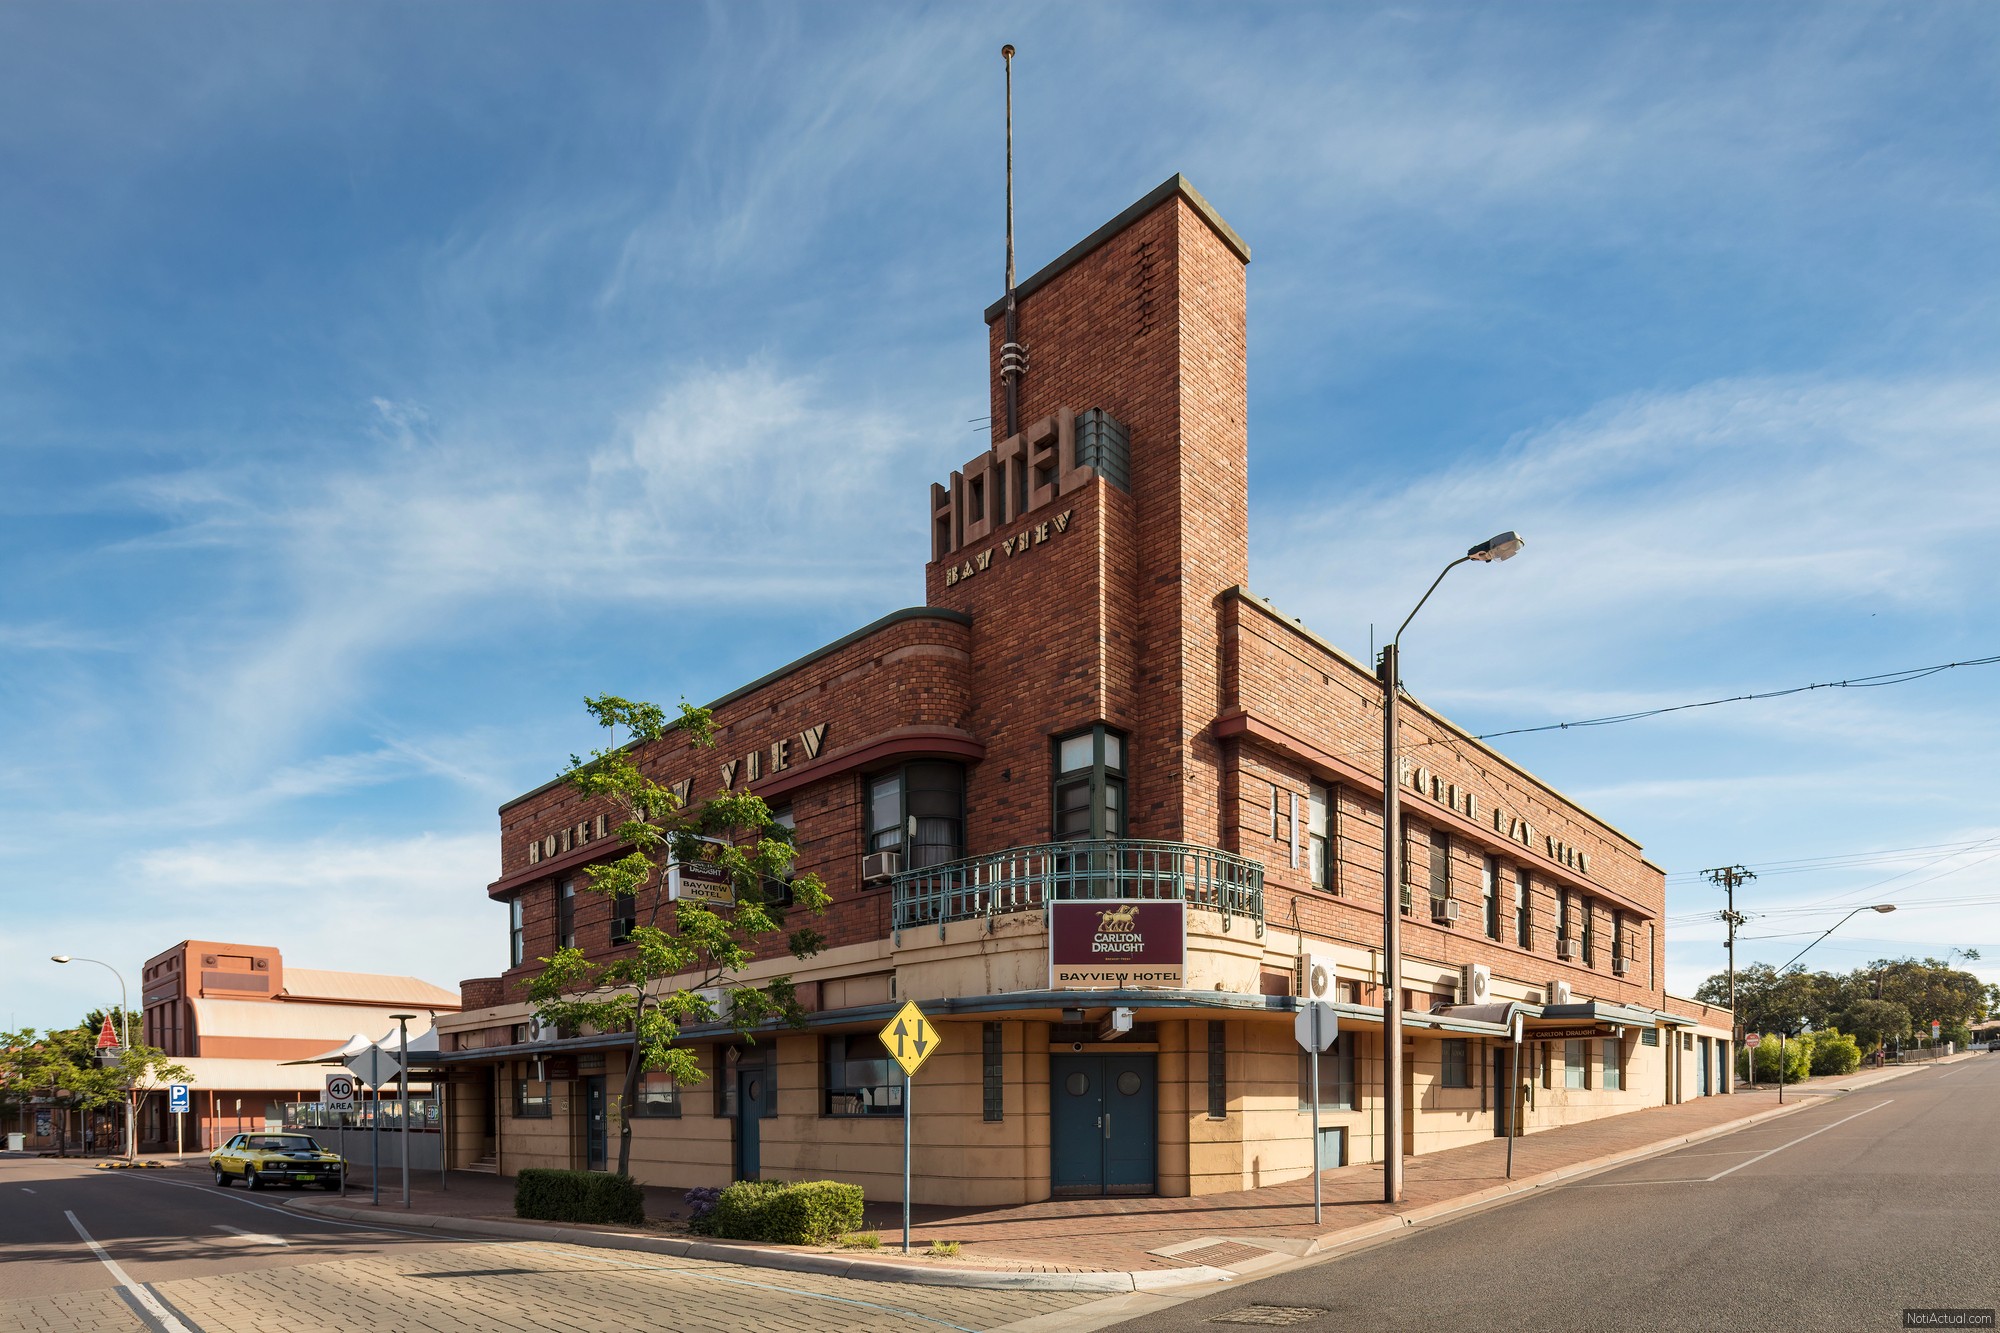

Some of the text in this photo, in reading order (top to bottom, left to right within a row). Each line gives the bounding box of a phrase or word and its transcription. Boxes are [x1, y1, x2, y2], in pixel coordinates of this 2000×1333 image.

[931, 406, 1093, 564] HOTEL
[946, 509, 1073, 587] BAY VIEW
[529, 723, 828, 864] HOTEL VIEW
[1546, 835, 1591, 875] VIEW
[683, 880, 728, 892] BAYVIEW
[691, 888, 722, 898] HOTEL
[1094, 933, 1142, 942] CARLTON
[1092, 943, 1144, 952] DRAUGHT
[1060, 972, 1181, 981] BAYVIEW HOTEL
[1565, 1029, 1596, 1037] DRAUGHT
[173, 1086, 185, 1099] P
[331, 1084, 350, 1095] 40
[330, 1102, 353, 1110] AREA
